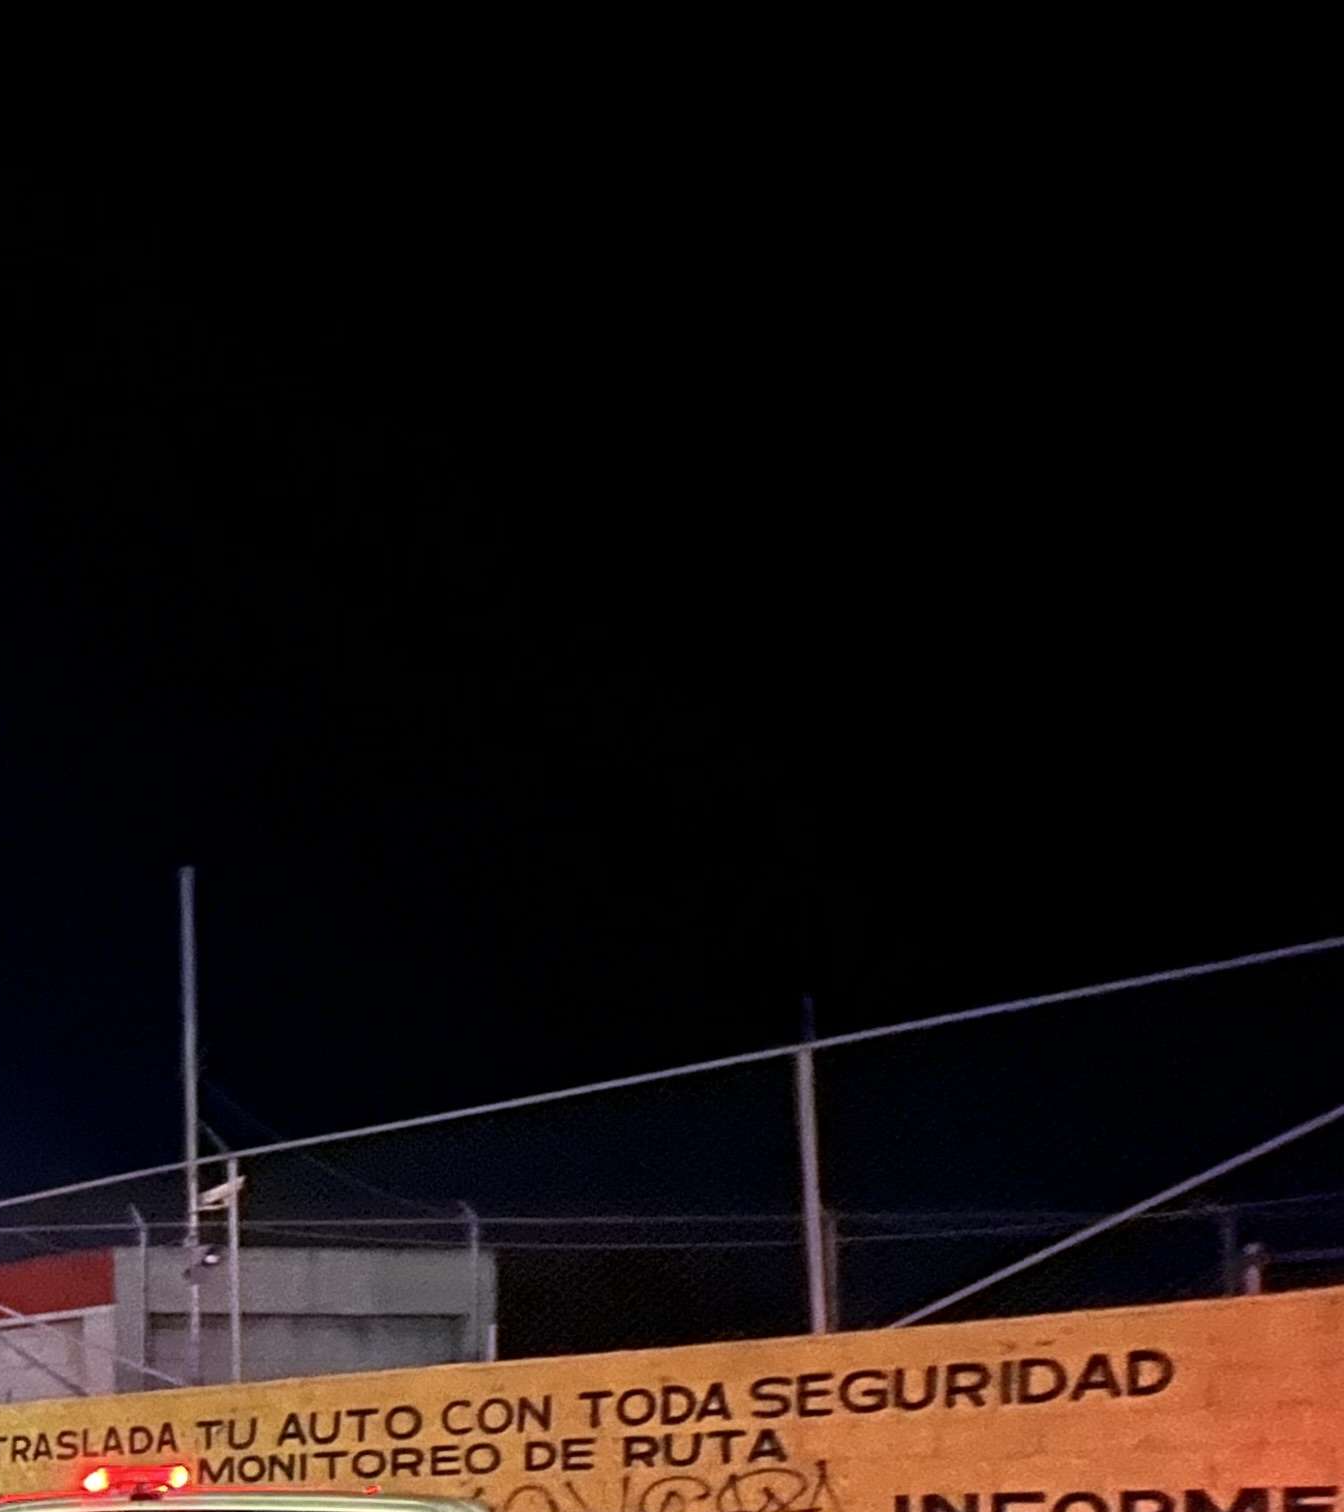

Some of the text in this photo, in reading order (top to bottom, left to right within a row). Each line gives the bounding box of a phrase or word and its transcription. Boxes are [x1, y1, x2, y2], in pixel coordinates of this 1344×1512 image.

[196, 1416, 258, 1451] TU
[277, 1404, 423, 1447] AUTO
[441, 1394, 553, 1436] CON
[579, 1382, 732, 1428] TODA
[750, 1348, 1175, 1420] SEGURIDAD
[196, 1428, 789, 1485] MONITOREO DE RUTA
